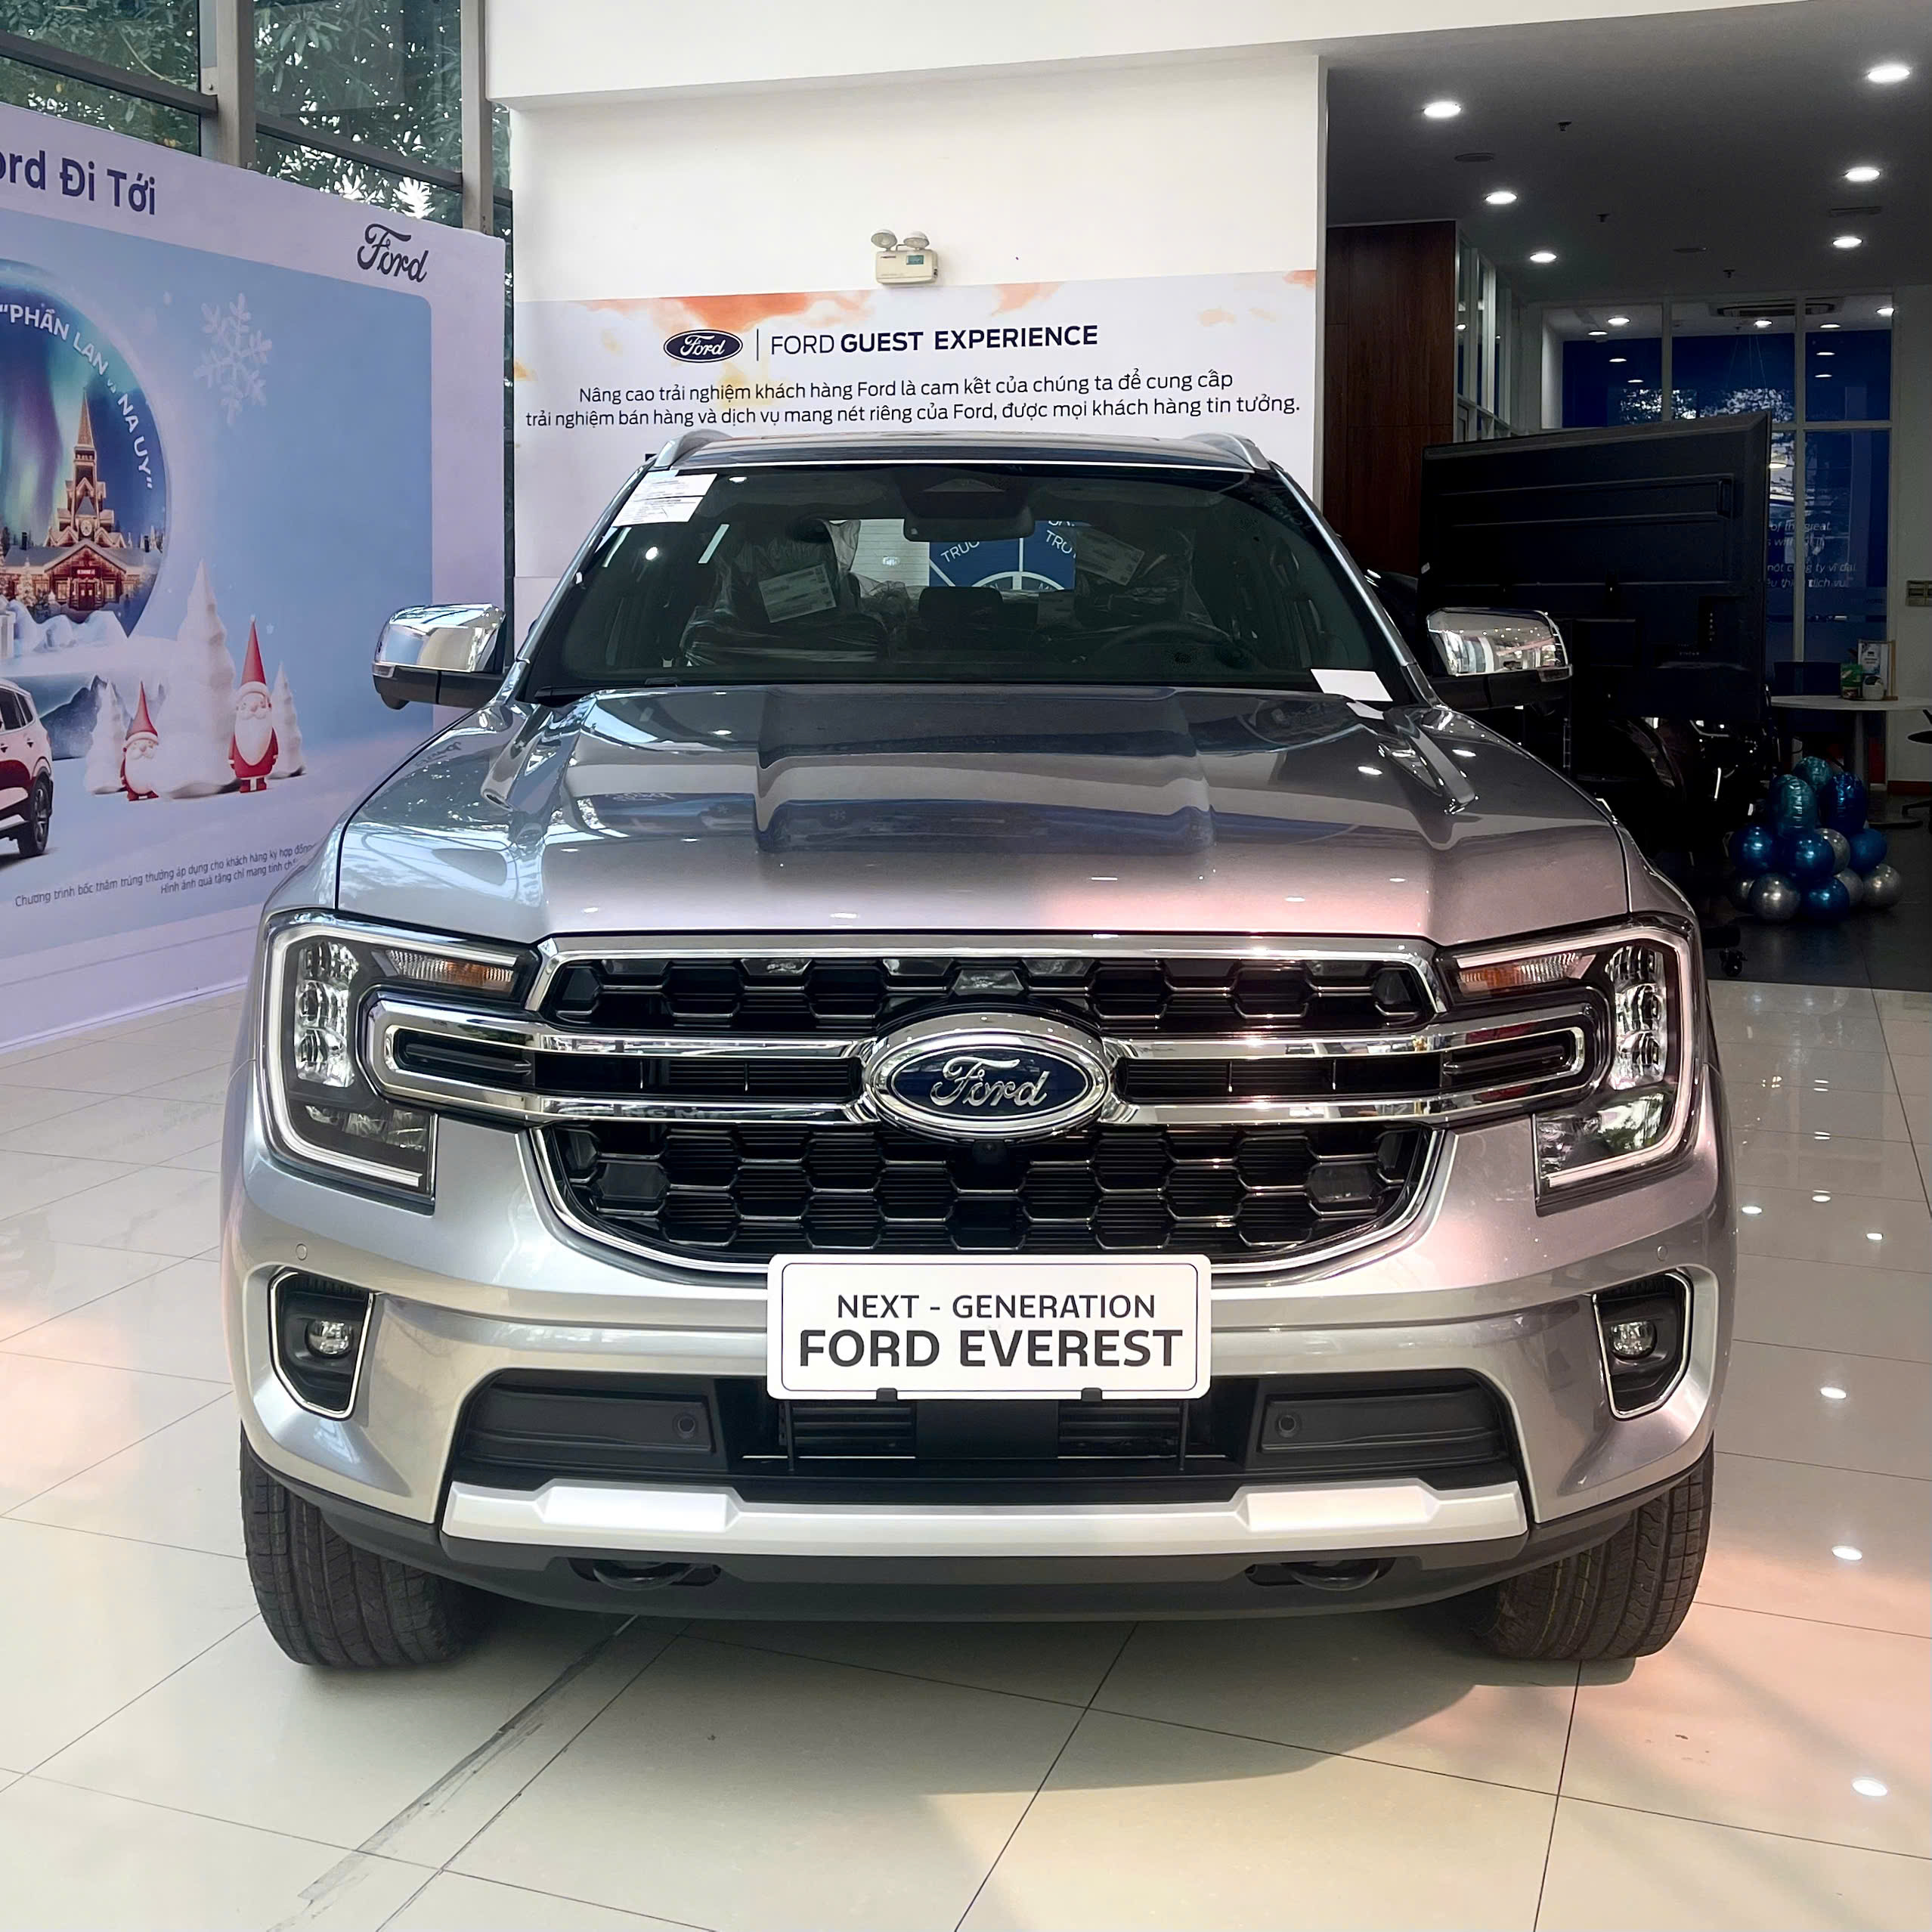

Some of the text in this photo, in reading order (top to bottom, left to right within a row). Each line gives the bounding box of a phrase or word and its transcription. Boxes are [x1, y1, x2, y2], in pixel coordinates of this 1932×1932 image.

[60, 157, 94, 201] Đi
[107, 169, 155, 215] Tới
[357, 223, 429, 283] Ford
[679, 333, 726, 358] Ford
[771, 325, 1098, 355] FORD GUEST EXPERIENCE
[73, 332, 108, 375] LAN
[117, 394, 139, 433] NA
[580, 368, 1233, 404] Nâng cao trải nghiệm khách hàng Ford là cam kết của chúng ta để cung cấp
[526, 393, 1300, 429] trải nghiệm bán hàng và dịch vụ mang nét riêng của Ford, được mọi khách hàng tin tưởng.
[930, 1057, 1050, 1107] Ford
[838, 1295, 919, 1318] NEXT
[952, 1294, 1155, 1319] GENERATION
[800, 1330, 1183, 1367] FORD EVEREST
